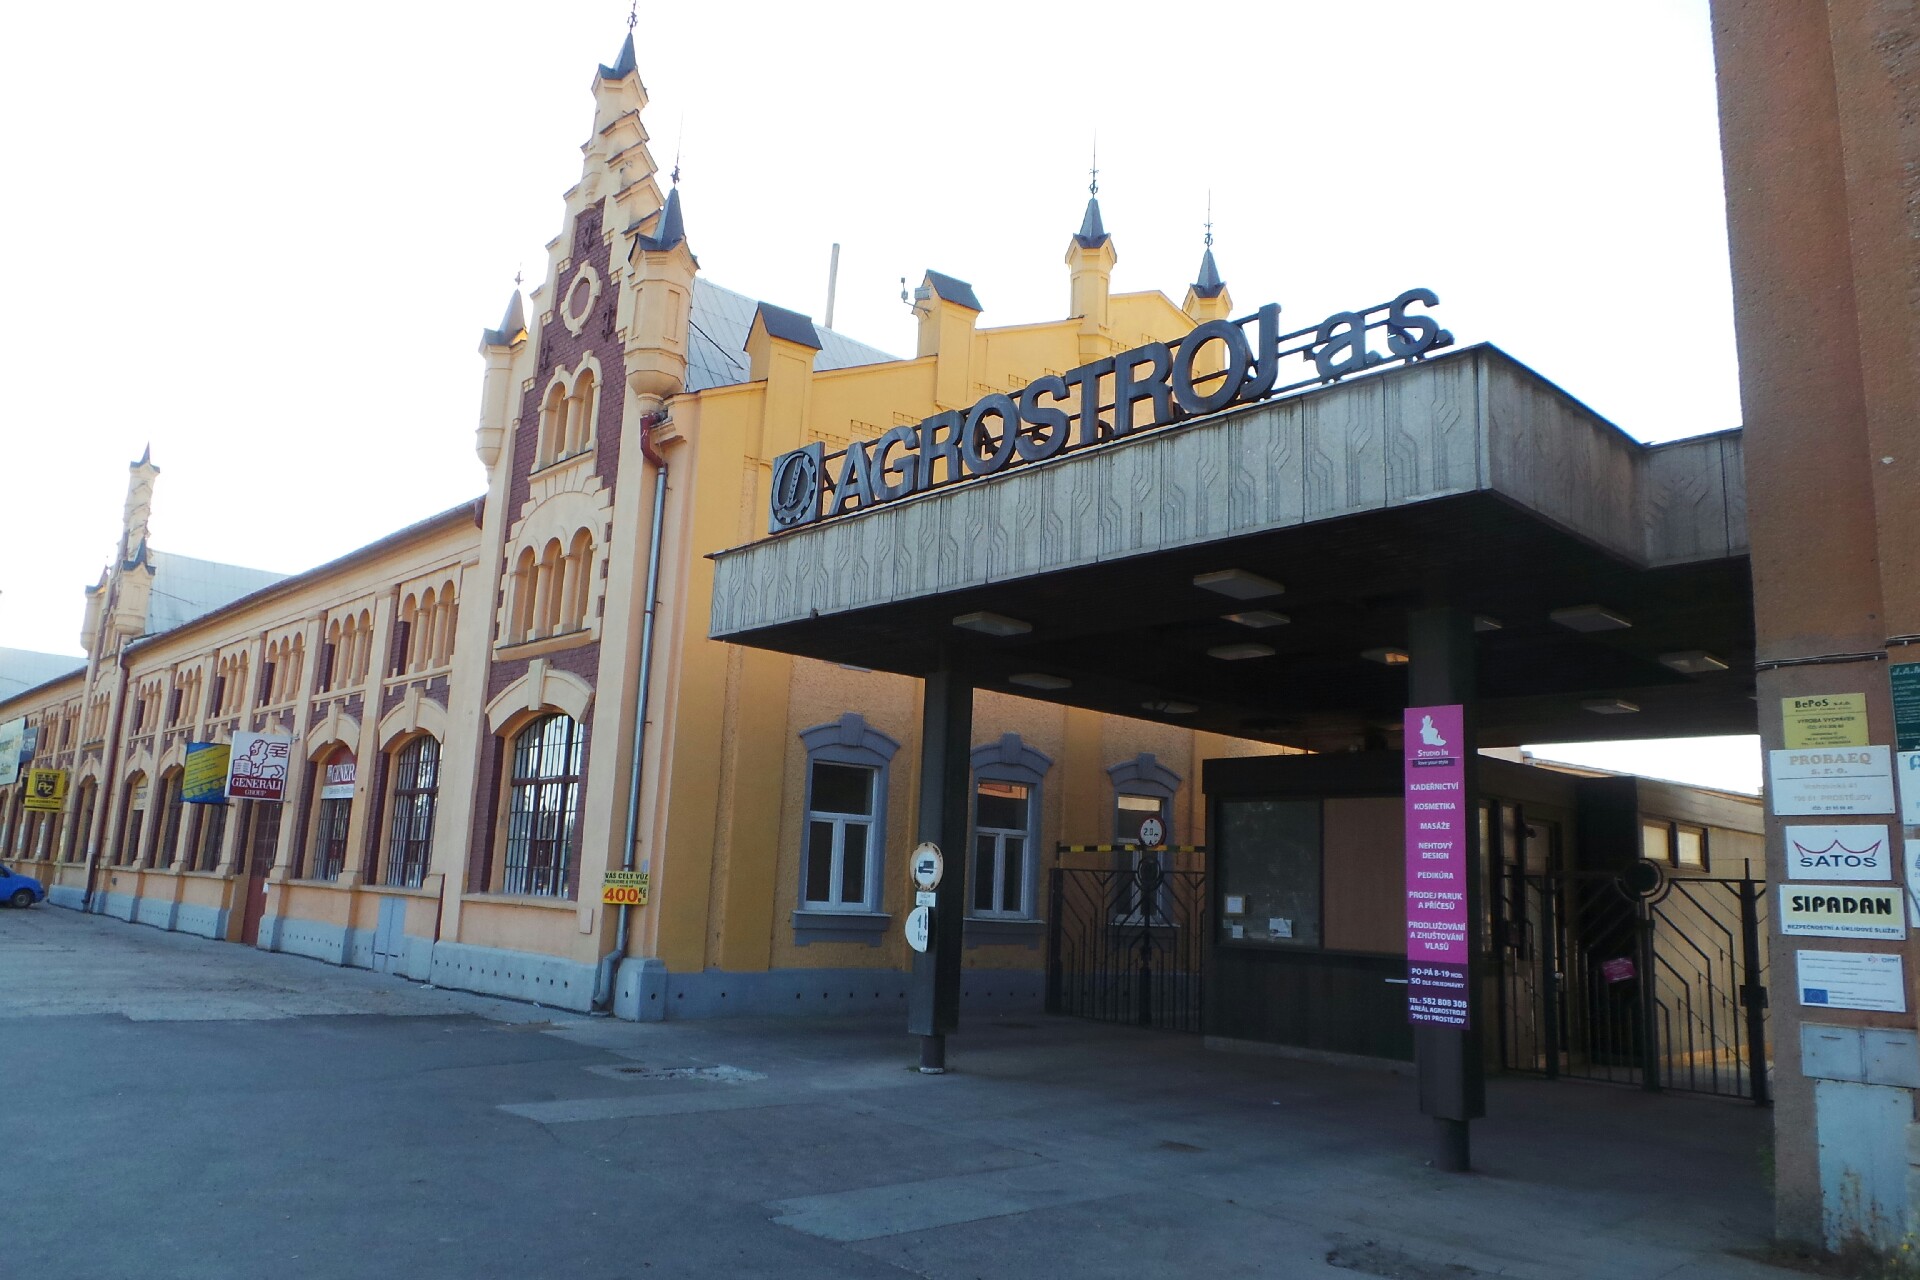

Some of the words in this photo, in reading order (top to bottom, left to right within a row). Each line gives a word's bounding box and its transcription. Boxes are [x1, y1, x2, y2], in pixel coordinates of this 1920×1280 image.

[828, 301, 1282, 517] AGROSTROJ
[1794, 698, 1829, 709] BePoS
[1789, 752, 1873, 766] PROBAEQ
[231, 777, 282, 790] GENERALI
[1410, 781, 1459, 791] KADEŘNICTVÍ
[244, 788, 267, 796] GROUP
[1414, 802, 1456, 811] KOSMETIKA
[1420, 821, 1451, 830] MASÁŽE
[1418, 841, 1453, 850] NEHTOVÝ
[1422, 852, 1449, 860] DESIGN
[1408, 891, 1437, 899] PRODEJ
[1437, 892, 1463, 900] PARUK
[1417, 901, 1424, 909] A
[1792, 895, 1892, 915] SIPADAN
[1408, 921, 1466, 931] PRODLUŽOVÁNÍ
[1841, 925, 1873, 933] ÚKLIDOVÉ
[1874, 926, 1899, 934] SLUŽBY
[1410, 931, 1416, 939] A
[1424, 942, 1449, 951] VLASŮ
[1411, 967, 1433, 976] PO-PÁ
[1434, 969, 1450, 978] 8-19
[1411, 977, 1421, 985] SO
[1422, 997, 1436, 1005] 582
[1410, 1004, 1429, 1013] AREÁL
[1429, 1007, 1467, 1017] AGROSTROJE
[1431, 1015, 1465, 1024] PROSTĚJOV
